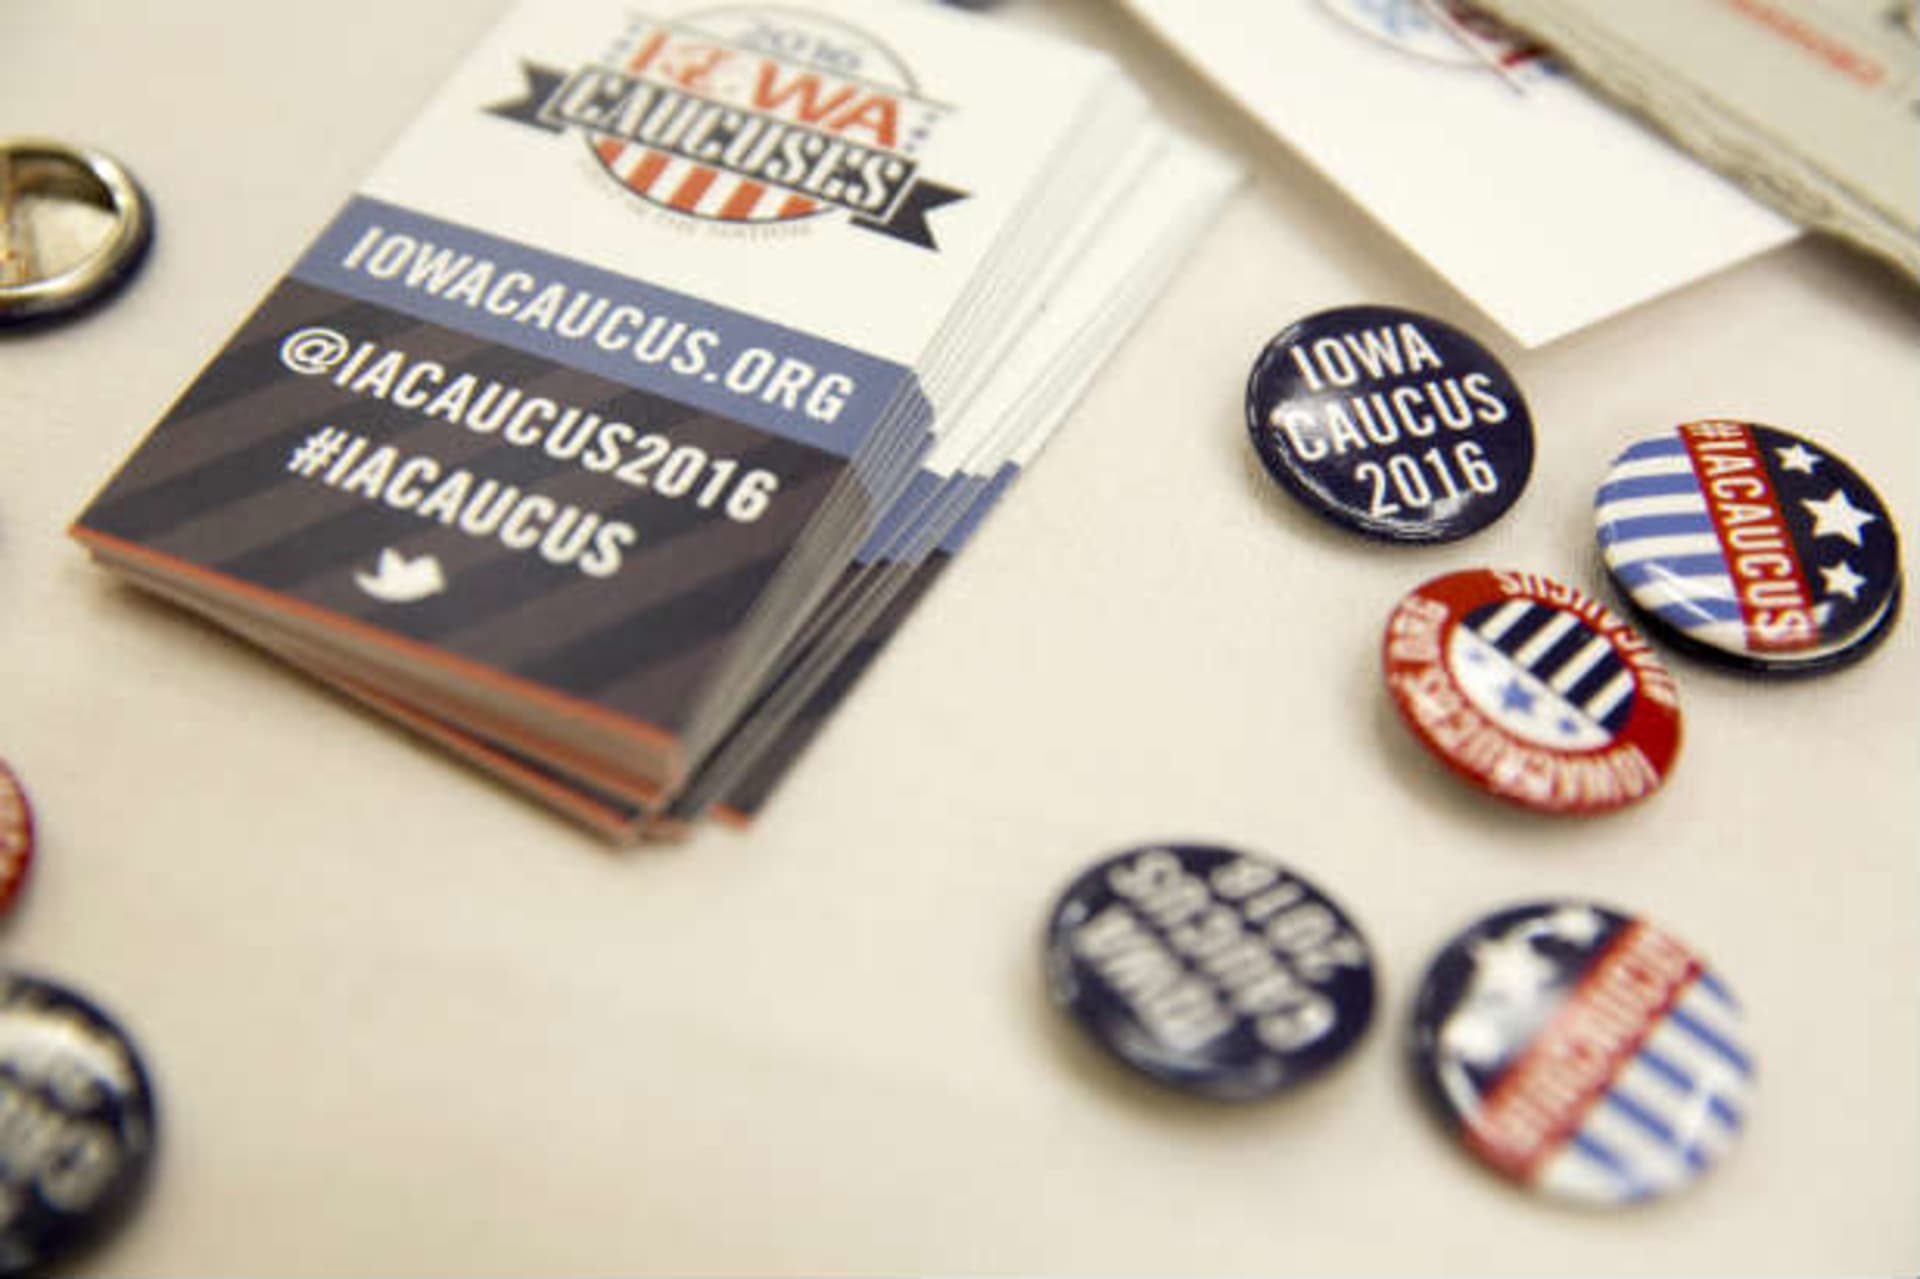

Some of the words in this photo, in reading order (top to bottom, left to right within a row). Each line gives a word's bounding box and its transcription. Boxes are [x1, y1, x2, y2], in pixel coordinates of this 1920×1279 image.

[560, 70, 902, 212] CAUCUSES
[341, 226, 856, 424] IOWACAUCUS.ORG
[1290, 321, 1443, 392] IOWA
[280, 326, 779, 523] @IACAUCUS2016
[1282, 372, 1508, 462] CAUCUS
[1354, 440, 1500, 518] 2016
[287, 425, 637, 577] #IACAUCUS
[1689, 420, 1811, 646] #IACAUCUS
